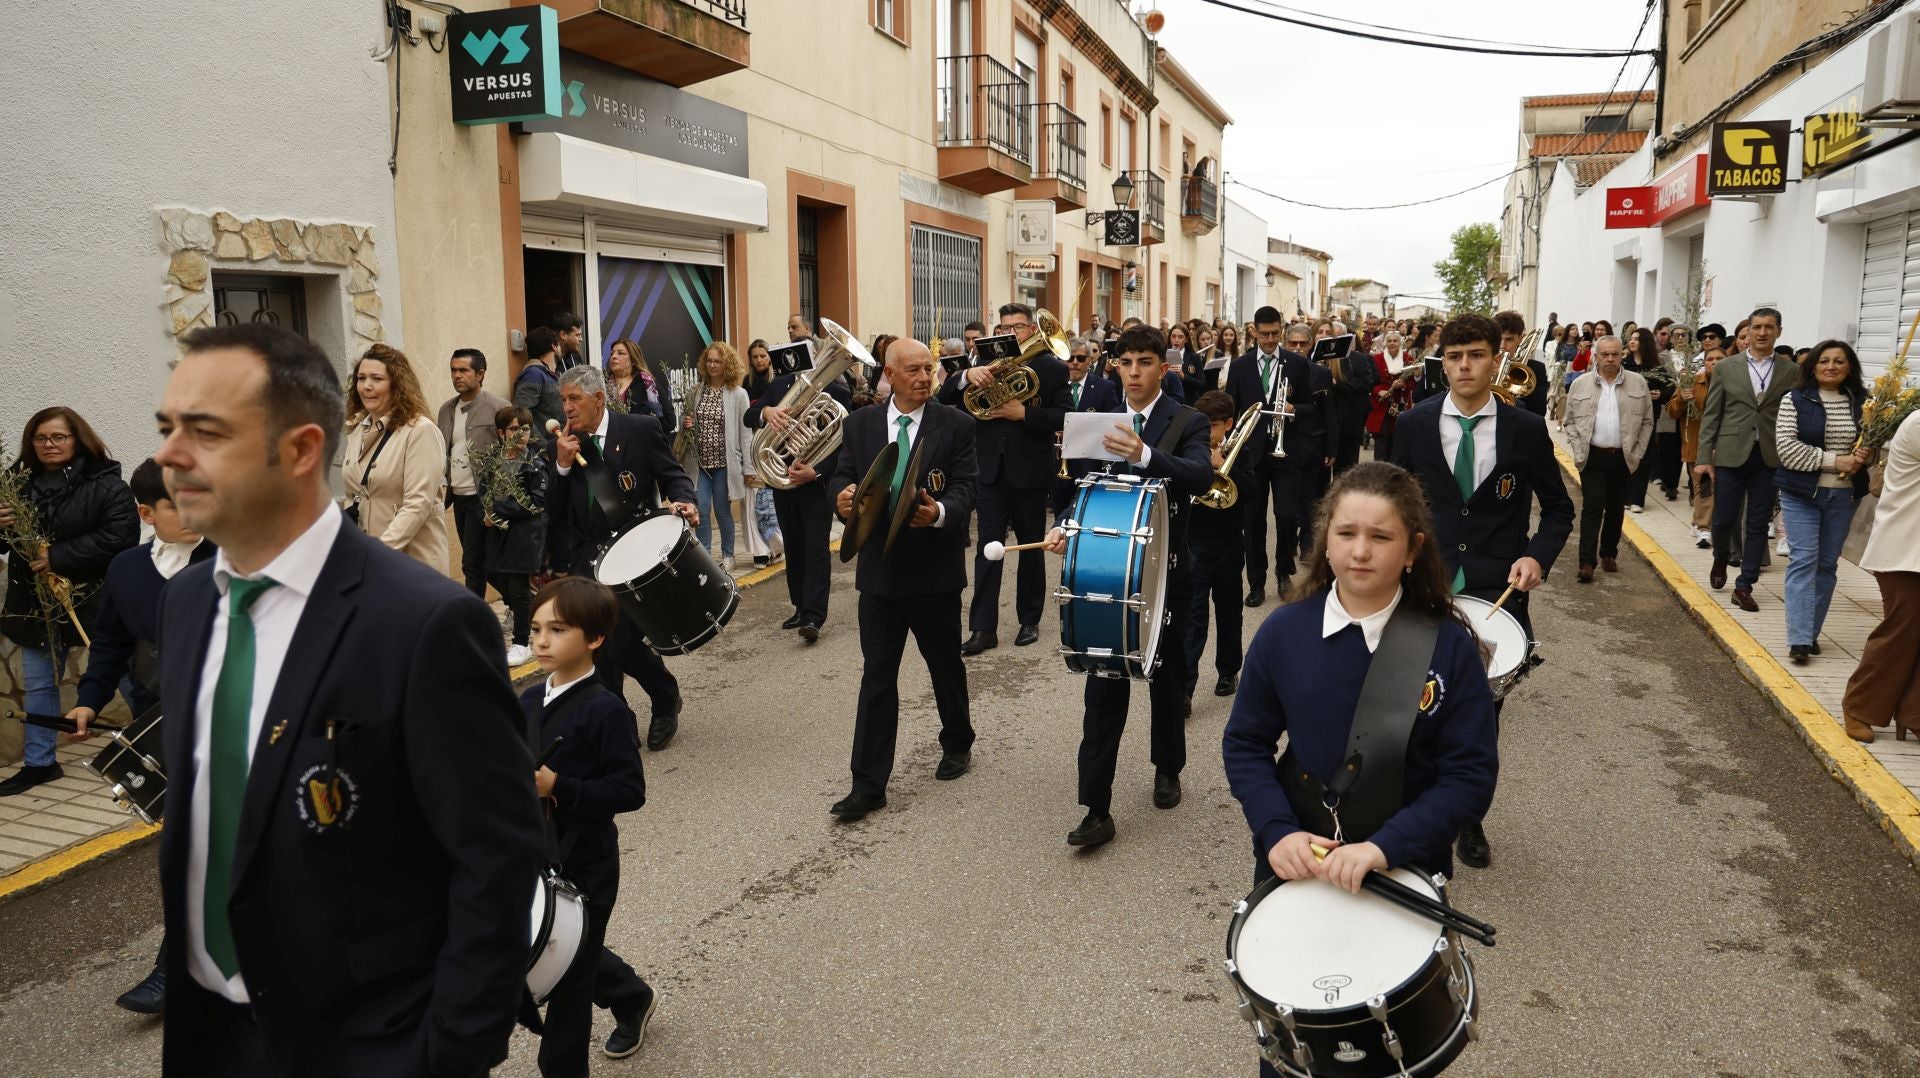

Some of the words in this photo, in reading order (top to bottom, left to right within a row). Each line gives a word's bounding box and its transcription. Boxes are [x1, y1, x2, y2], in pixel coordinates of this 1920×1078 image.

[463, 72, 532, 91] VERSUS
[488, 90, 532, 101] APUESTAS
[593, 94, 646, 123] VERSUS
[664, 115, 691, 132] TIENDA
[692, 124, 702, 136] DE
[703, 128, 739, 147] APUESTAS
[678, 133, 692, 146] LOS
[693, 138, 726, 155] DUENDES
[1715, 168, 1781, 187] TABACOS
[1658, 173, 1688, 212] MAPFRE
[1609, 208, 1646, 216] MAPFRE
